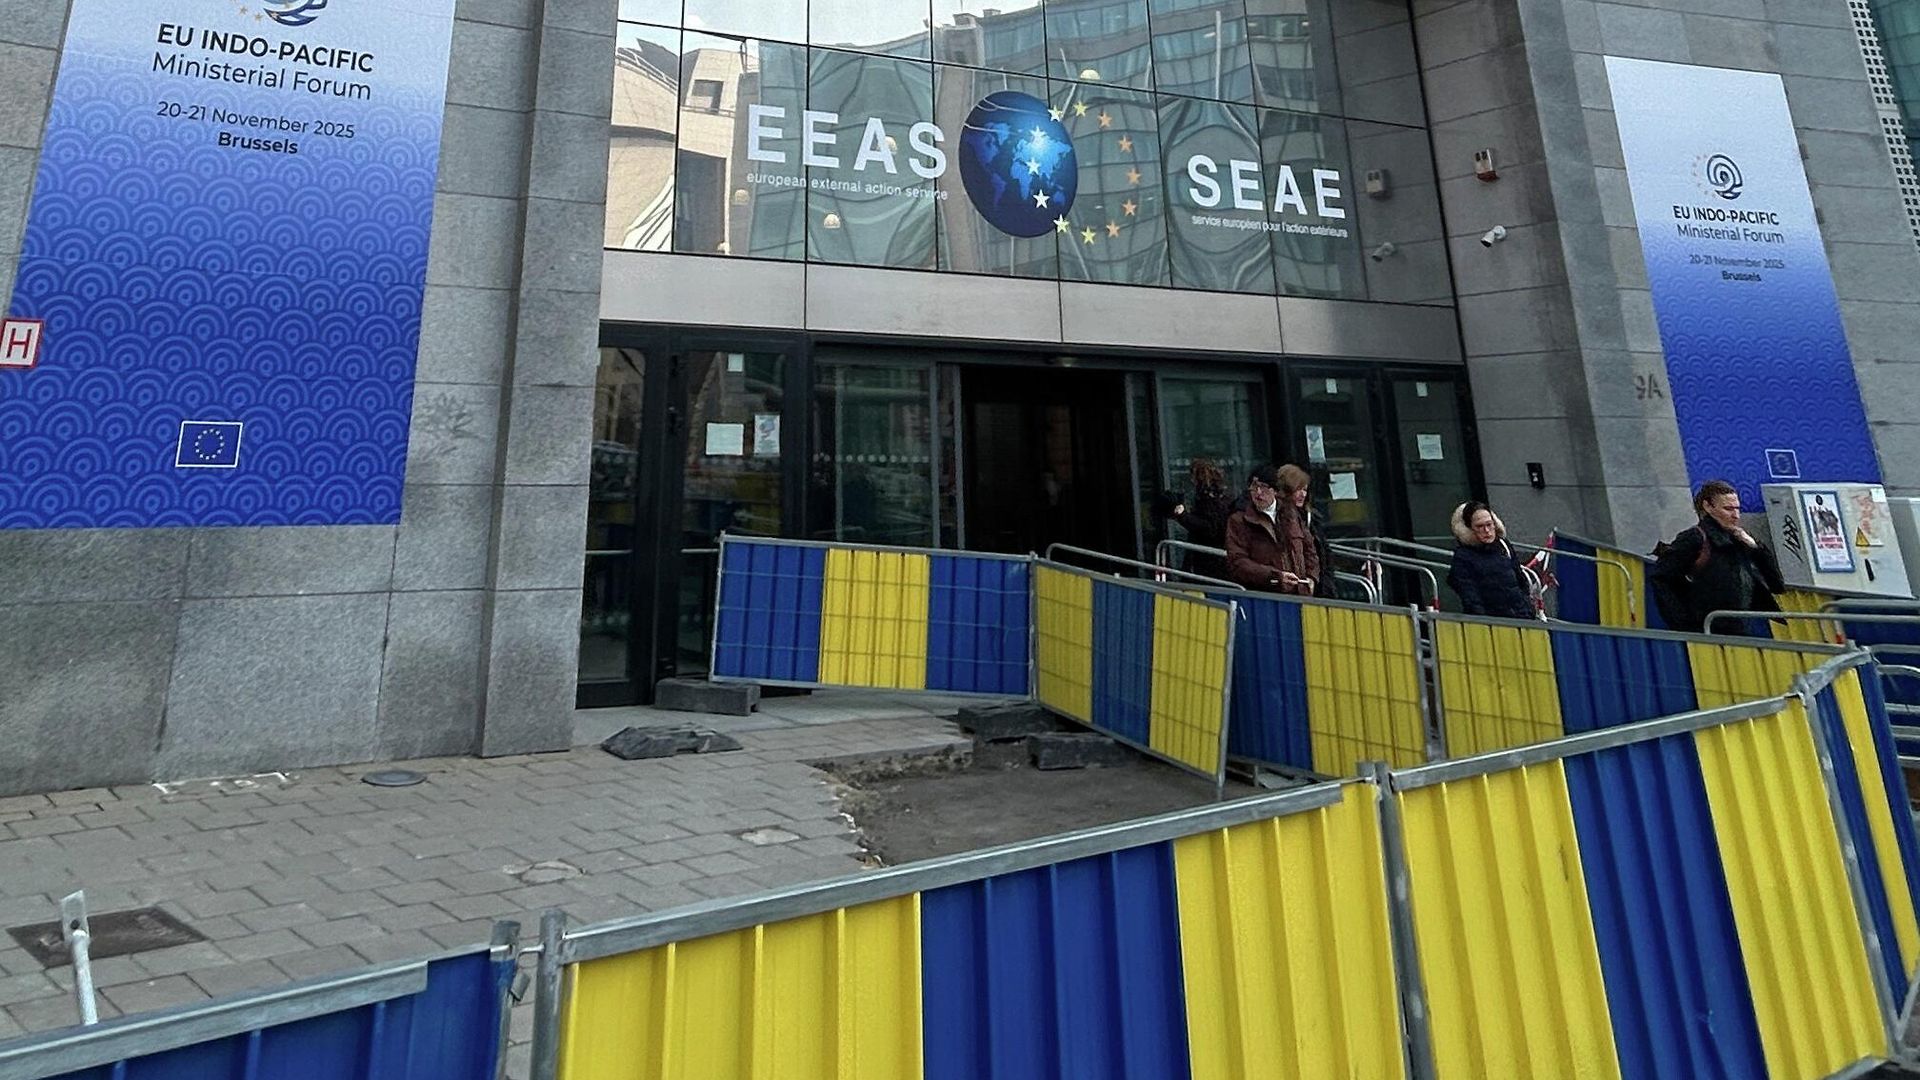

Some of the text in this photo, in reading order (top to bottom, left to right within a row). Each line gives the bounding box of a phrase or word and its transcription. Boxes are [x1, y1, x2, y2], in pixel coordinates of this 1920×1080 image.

[157, 23, 375, 73] EU INDO-PACIFIC
[152, 51, 371, 100] Ministerial Forum
[156, 100, 355, 139] 20-21 November 2025
[218, 131, 298, 154] Brussels
[747, 103, 947, 179] EEAS
[746, 172, 948, 200] european external action service
[1187, 154, 1346, 219] SEAE
[1191, 215, 1222, 227] service
[1262, 220, 1281, 233] pour
[1672, 205, 1780, 226] EU INDO-PACIFIC
[1676, 224, 1785, 243] Ministerial Forum
[1688, 254, 1785, 269] 20-21 November 2025
[1721, 270, 1762, 282] Brussels
[6, 327, 33, 359] H
